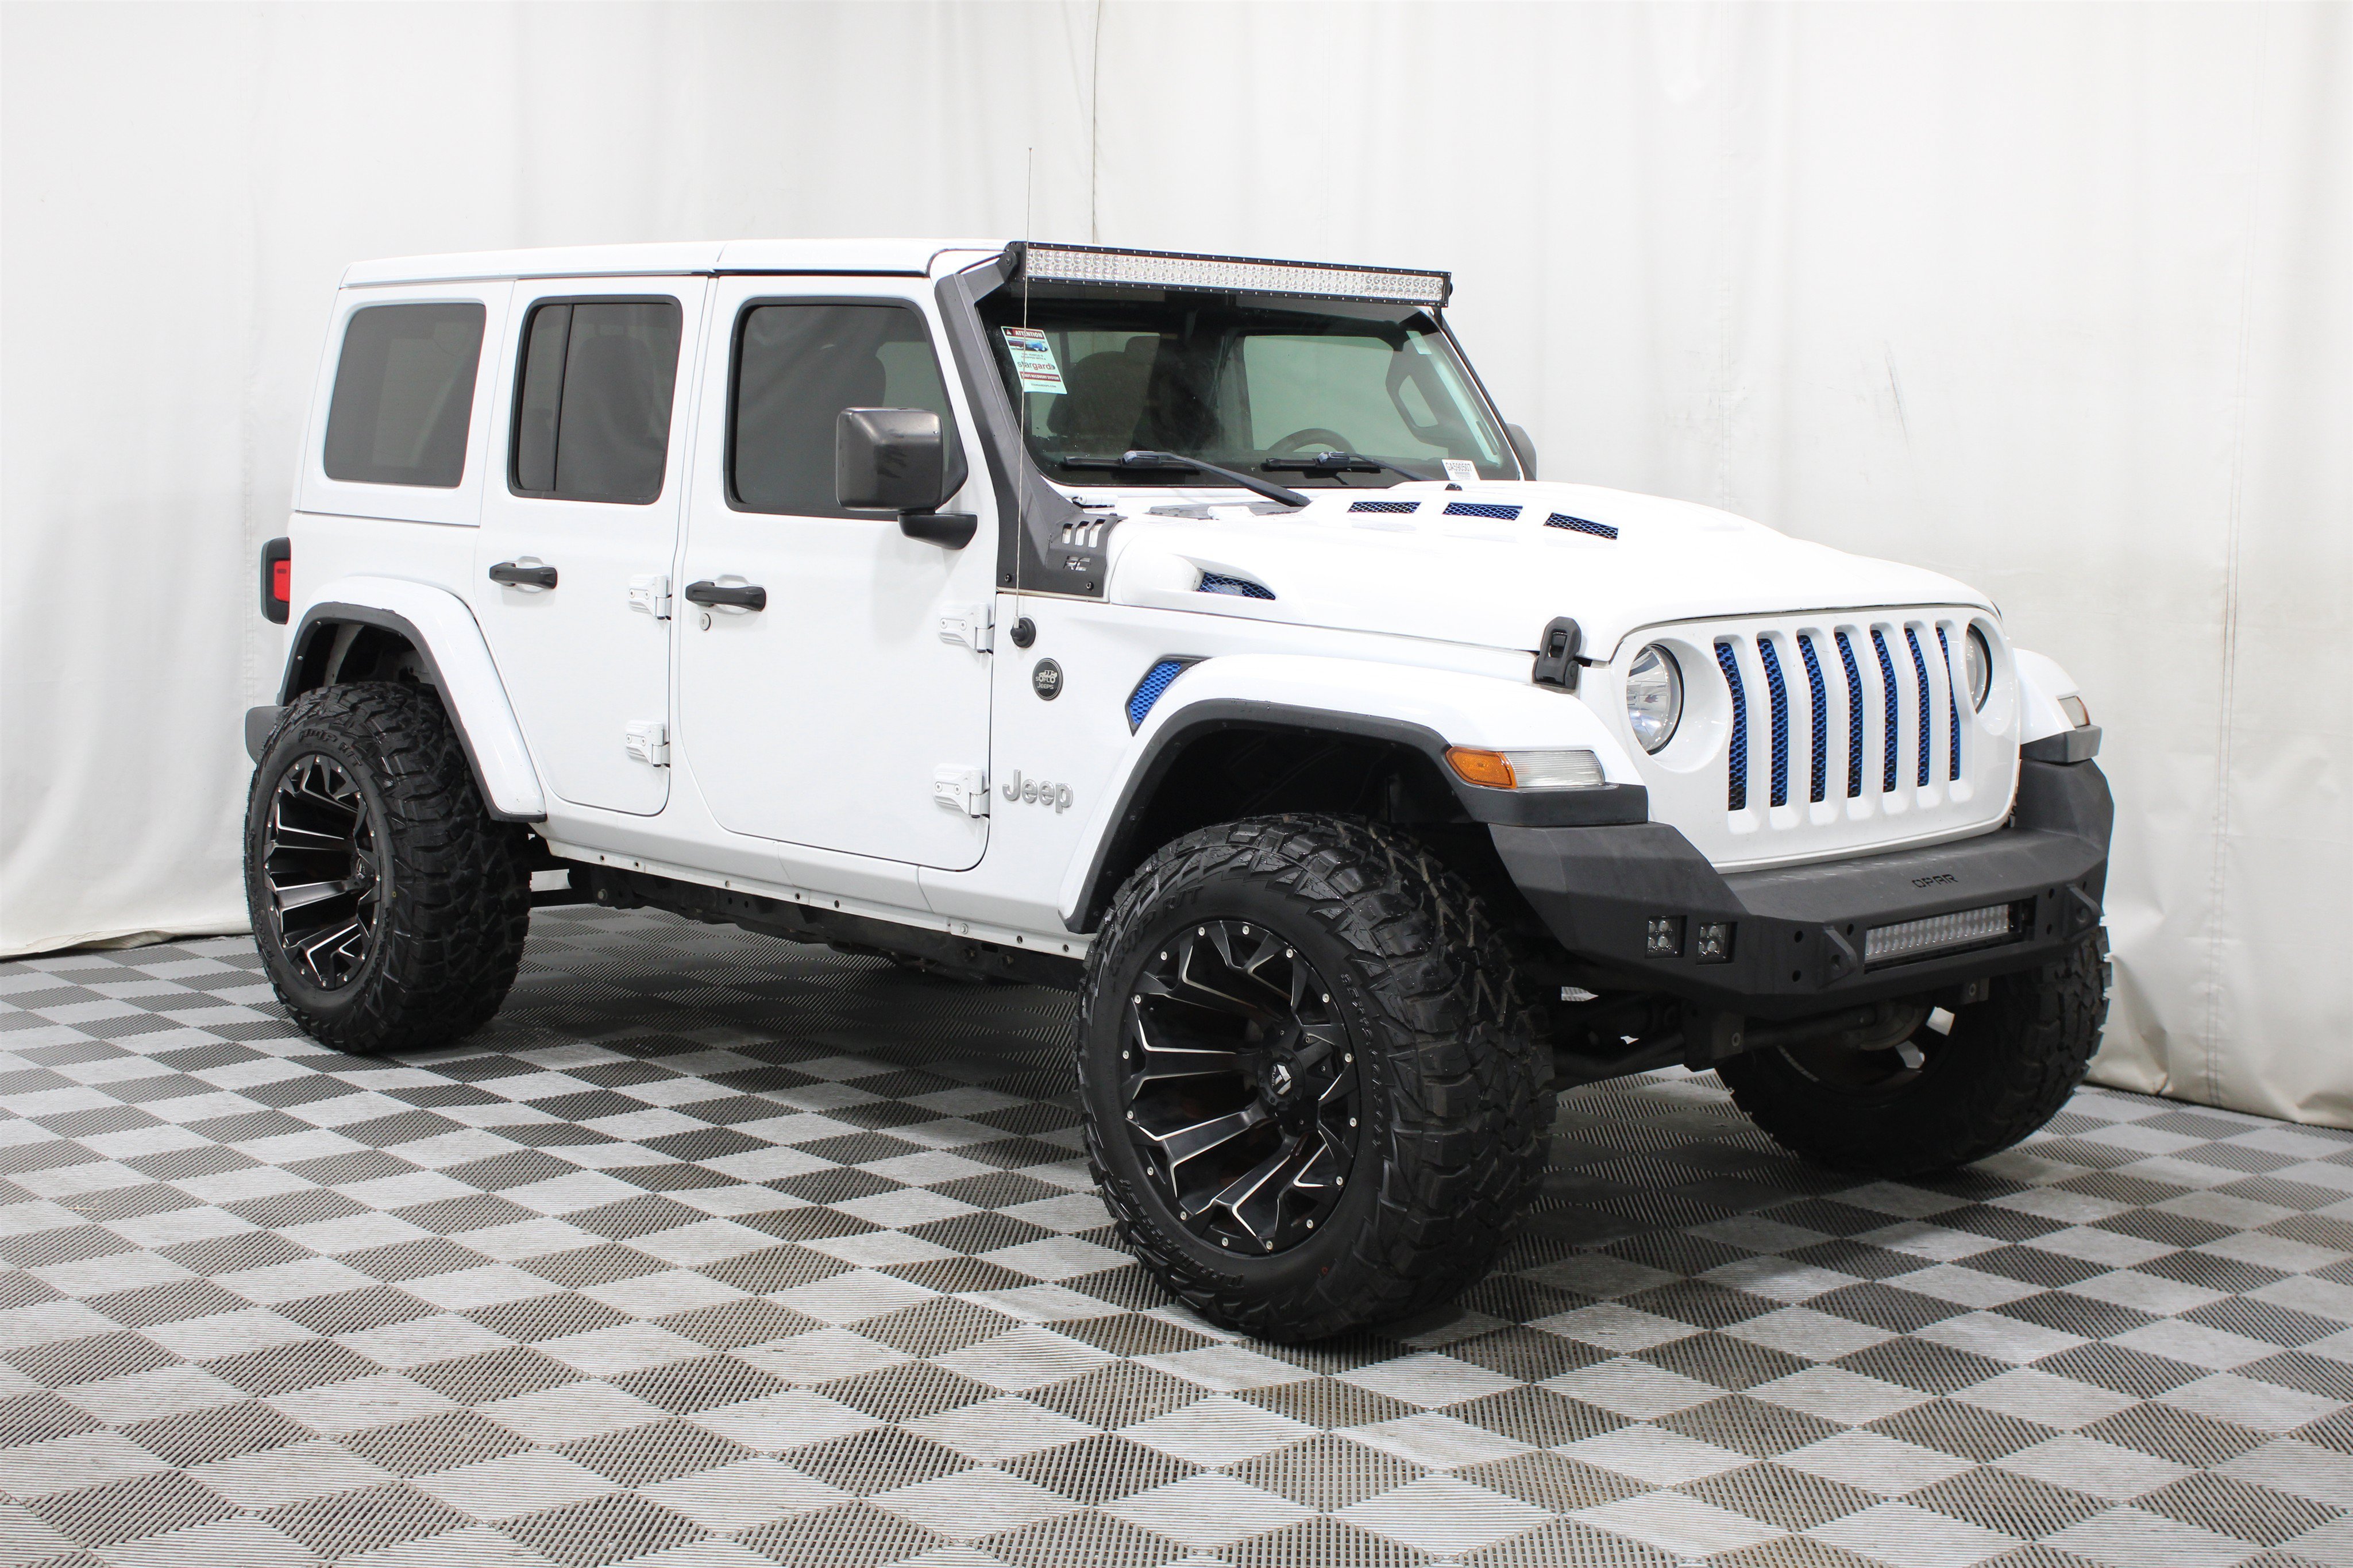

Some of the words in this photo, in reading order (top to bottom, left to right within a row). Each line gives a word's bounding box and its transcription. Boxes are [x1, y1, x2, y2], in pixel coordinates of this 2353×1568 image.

[1015, 330, 1043, 338] ATTENTION
[1445, 462, 1472, 472] GA590507
[1002, 769, 1074, 814] Jeep
[1912, 874, 1958, 888] OPAR
